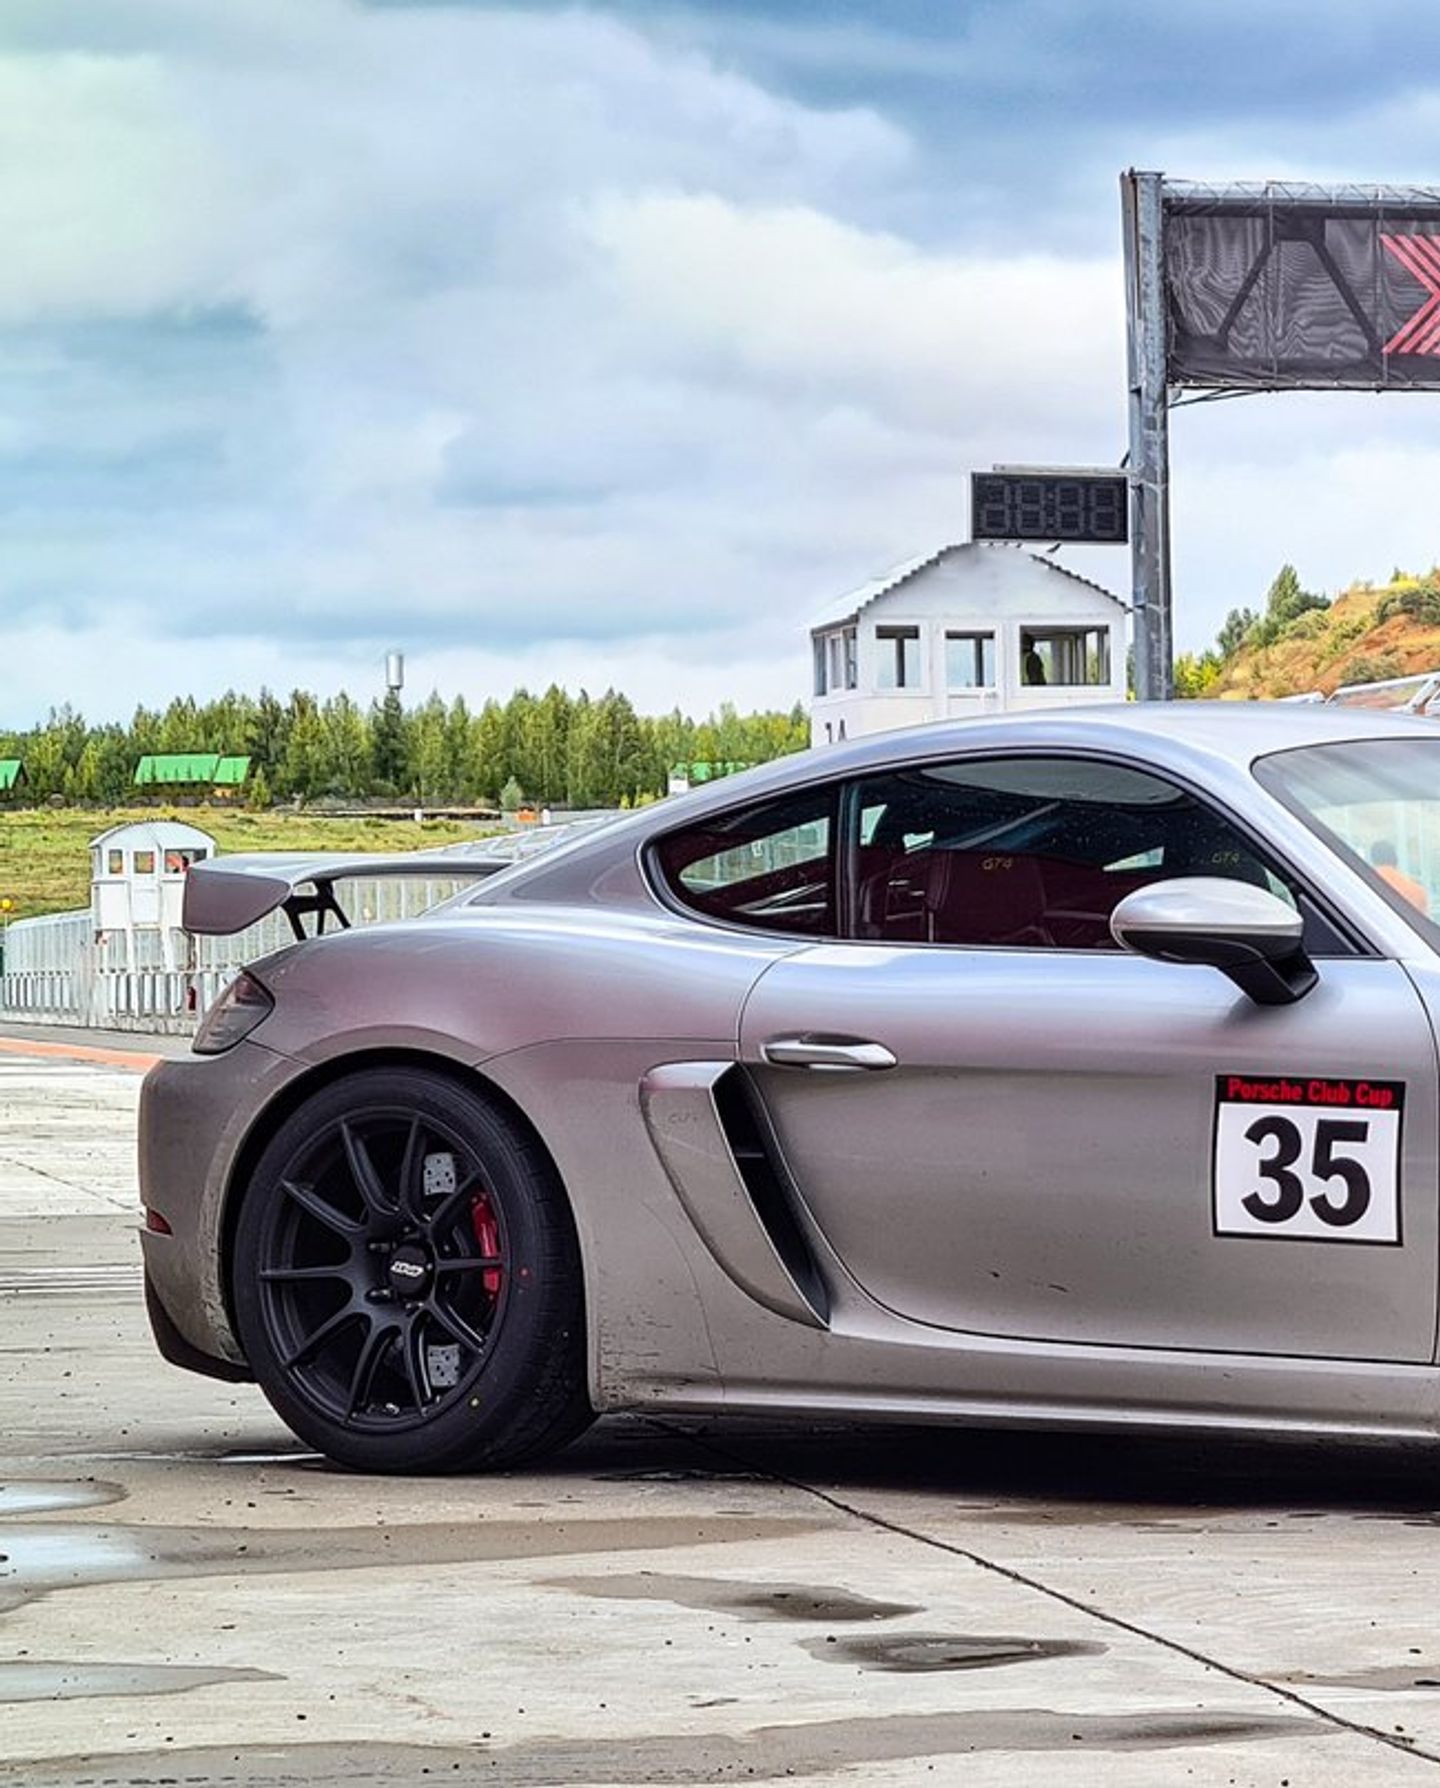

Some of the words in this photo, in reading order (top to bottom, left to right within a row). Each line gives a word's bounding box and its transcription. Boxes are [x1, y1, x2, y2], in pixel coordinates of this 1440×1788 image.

[1227, 1077, 1303, 1100] Porsche
[1307, 1080, 1350, 1103] Club
[1355, 1083, 1393, 1108] Cup
[1241, 1114, 1371, 1227] 35
